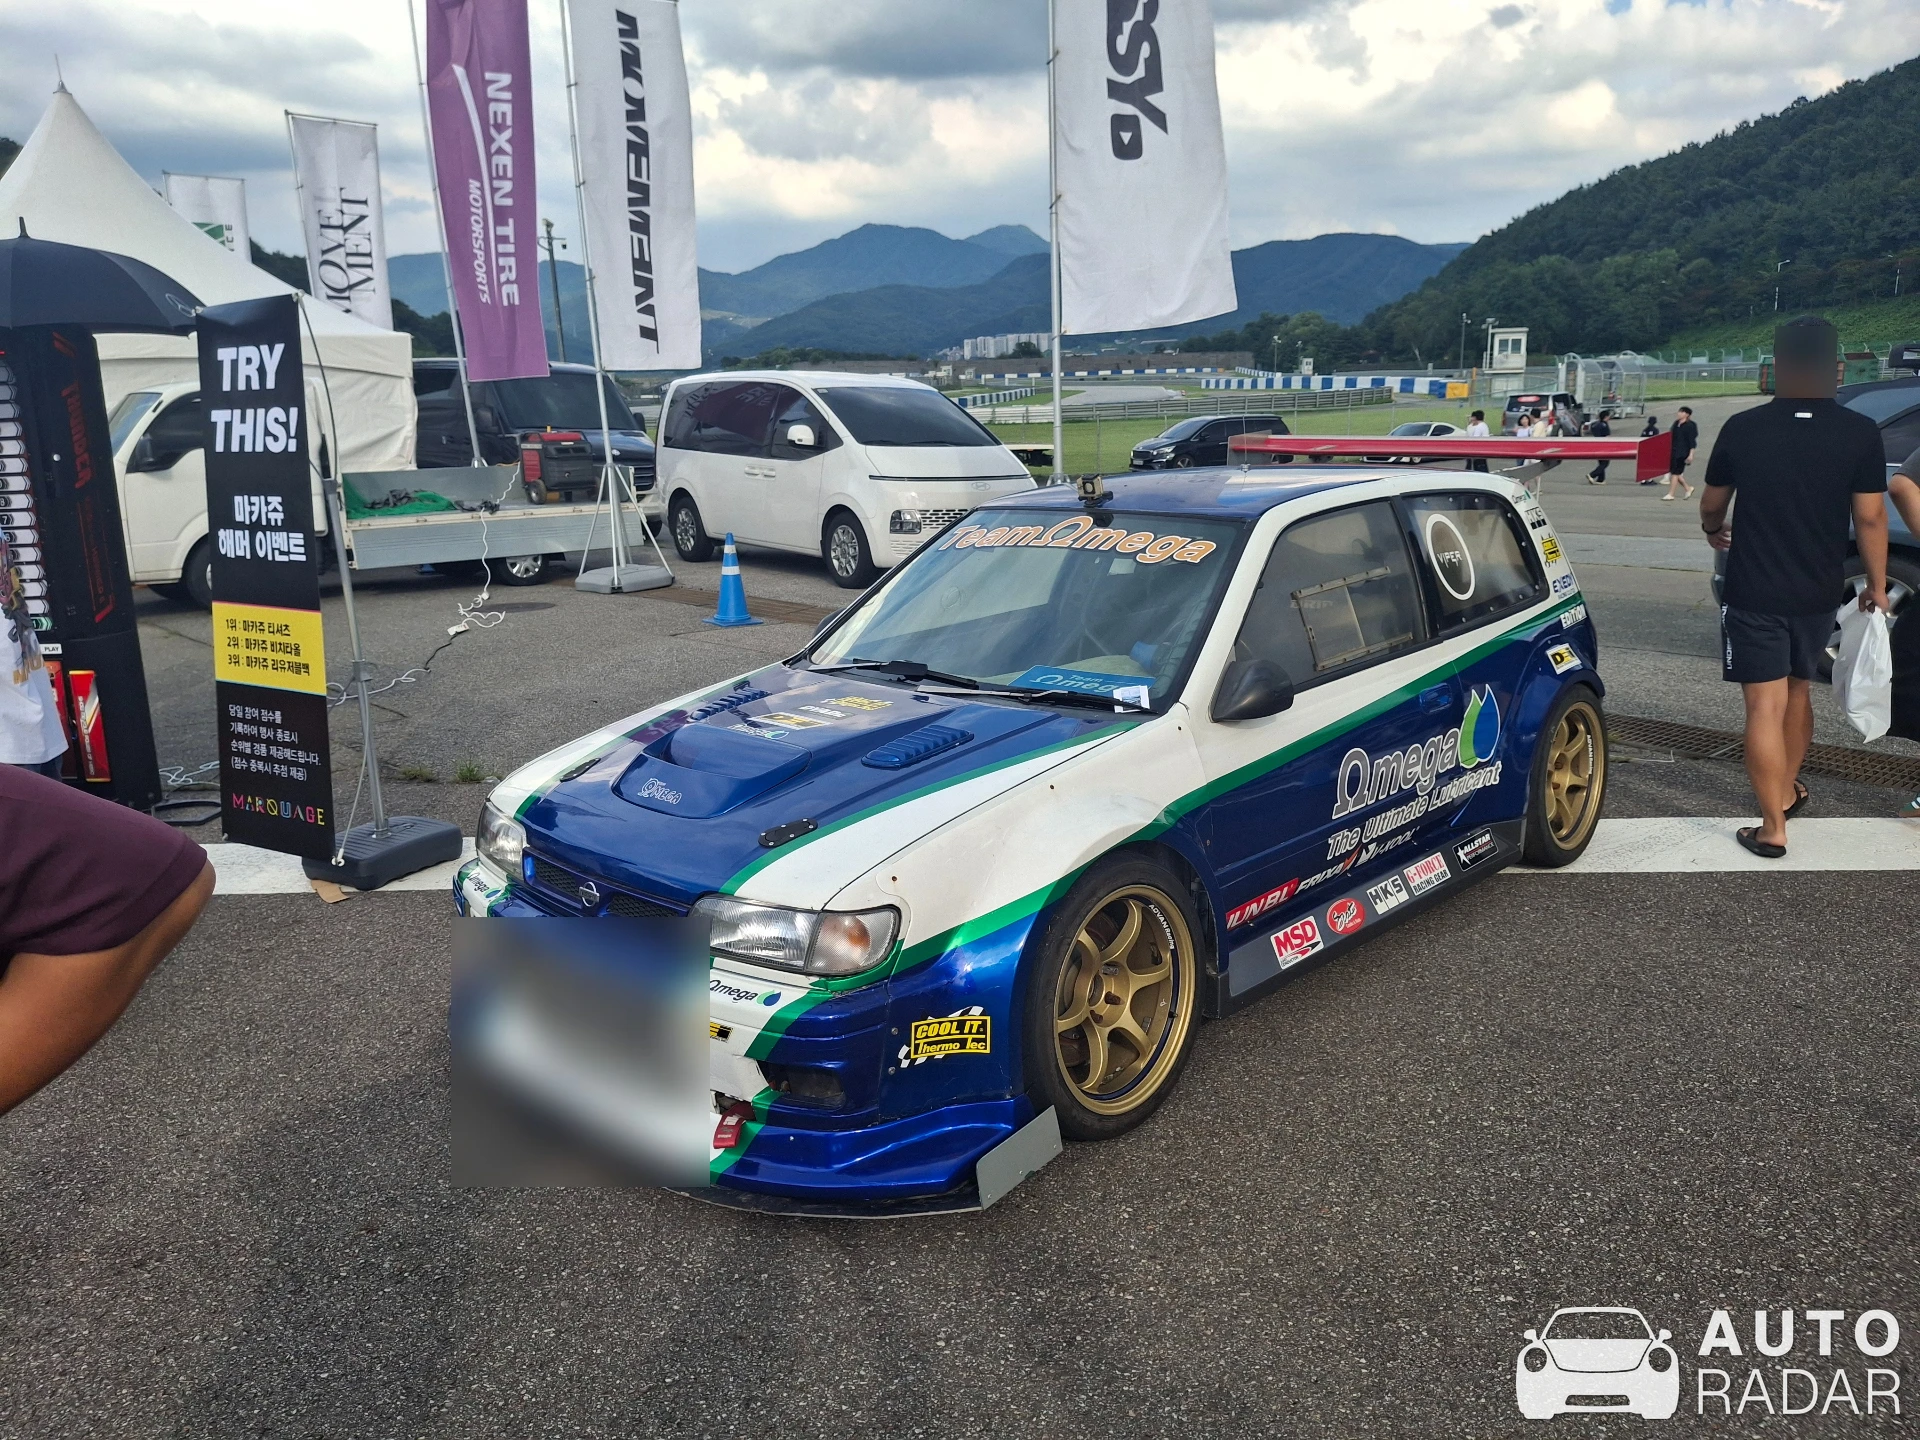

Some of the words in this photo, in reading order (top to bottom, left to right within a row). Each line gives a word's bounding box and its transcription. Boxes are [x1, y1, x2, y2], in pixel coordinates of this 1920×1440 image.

[484, 72, 515, 206] NEXEN
[616, 9, 659, 354] MOVEMENT
[468, 179, 491, 305] MOTORSPORTS
[495, 218, 520, 306] TIRE
[217, 343, 285, 391] TRY
[61, 381, 95, 488] THUNDER
[211, 407, 298, 453] THIS!
[234, 495, 284, 526] 마카쥬
[218, 528, 250, 560] 해머
[255, 530, 306, 562] 이벤트
[1436, 550, 1463, 568] VIPER
[226, 618, 237, 631] 1위
[242, 620, 266, 634] 마카쥬
[267, 622, 291, 636] 티셔츠
[227, 636, 239, 649] 2위
[245, 638, 268, 652] 마카쥬
[270, 640, 301, 657] 비치타올
[228, 654, 240, 667] 3위
[246, 656, 270, 671] 마카쥬
[271, 659, 310, 676] 리유저블백
[228, 704, 243, 718] 당일
[244, 706, 259, 720] 참여
[260, 708, 282, 724] 점수를
[230, 722, 257, 737] 기록하여
[259, 726, 274, 740] 행사
[276, 729, 298, 744] 종료시
[231, 739, 251, 754] 순위별
[252, 743, 267, 756] 경품
[269, 746, 321, 765] 제공해드립니다.
[231, 756, 248, 769] (점수
[250, 759, 271, 775] 중복시
[273, 764, 288, 778] 추첨
[289, 767, 307, 781] 제공)
[232, 792, 325, 826] MARQUAGE
[1327, 827, 1362, 861] The
[1362, 796, 1428, 843] Ultimate
[1427, 760, 1503, 812] Lubricant
[1463, 833, 1491, 854] ALLSTAR
[1405, 854, 1445, 884] G-FORCE
[1412, 876, 1434, 893] RACING
[1433, 869, 1449, 883] GEAR
[1369, 877, 1404, 906] HKS
[1149, 904, 1169, 928] ADVAN
[1164, 928, 1175, 950] Racing
[1273, 920, 1317, 957] MSD
[916, 1021, 960, 1039] COOL
[963, 1020, 982, 1033] IT
[915, 1039, 960, 1054] Thermo
[965, 1036, 986, 1050] Tec
